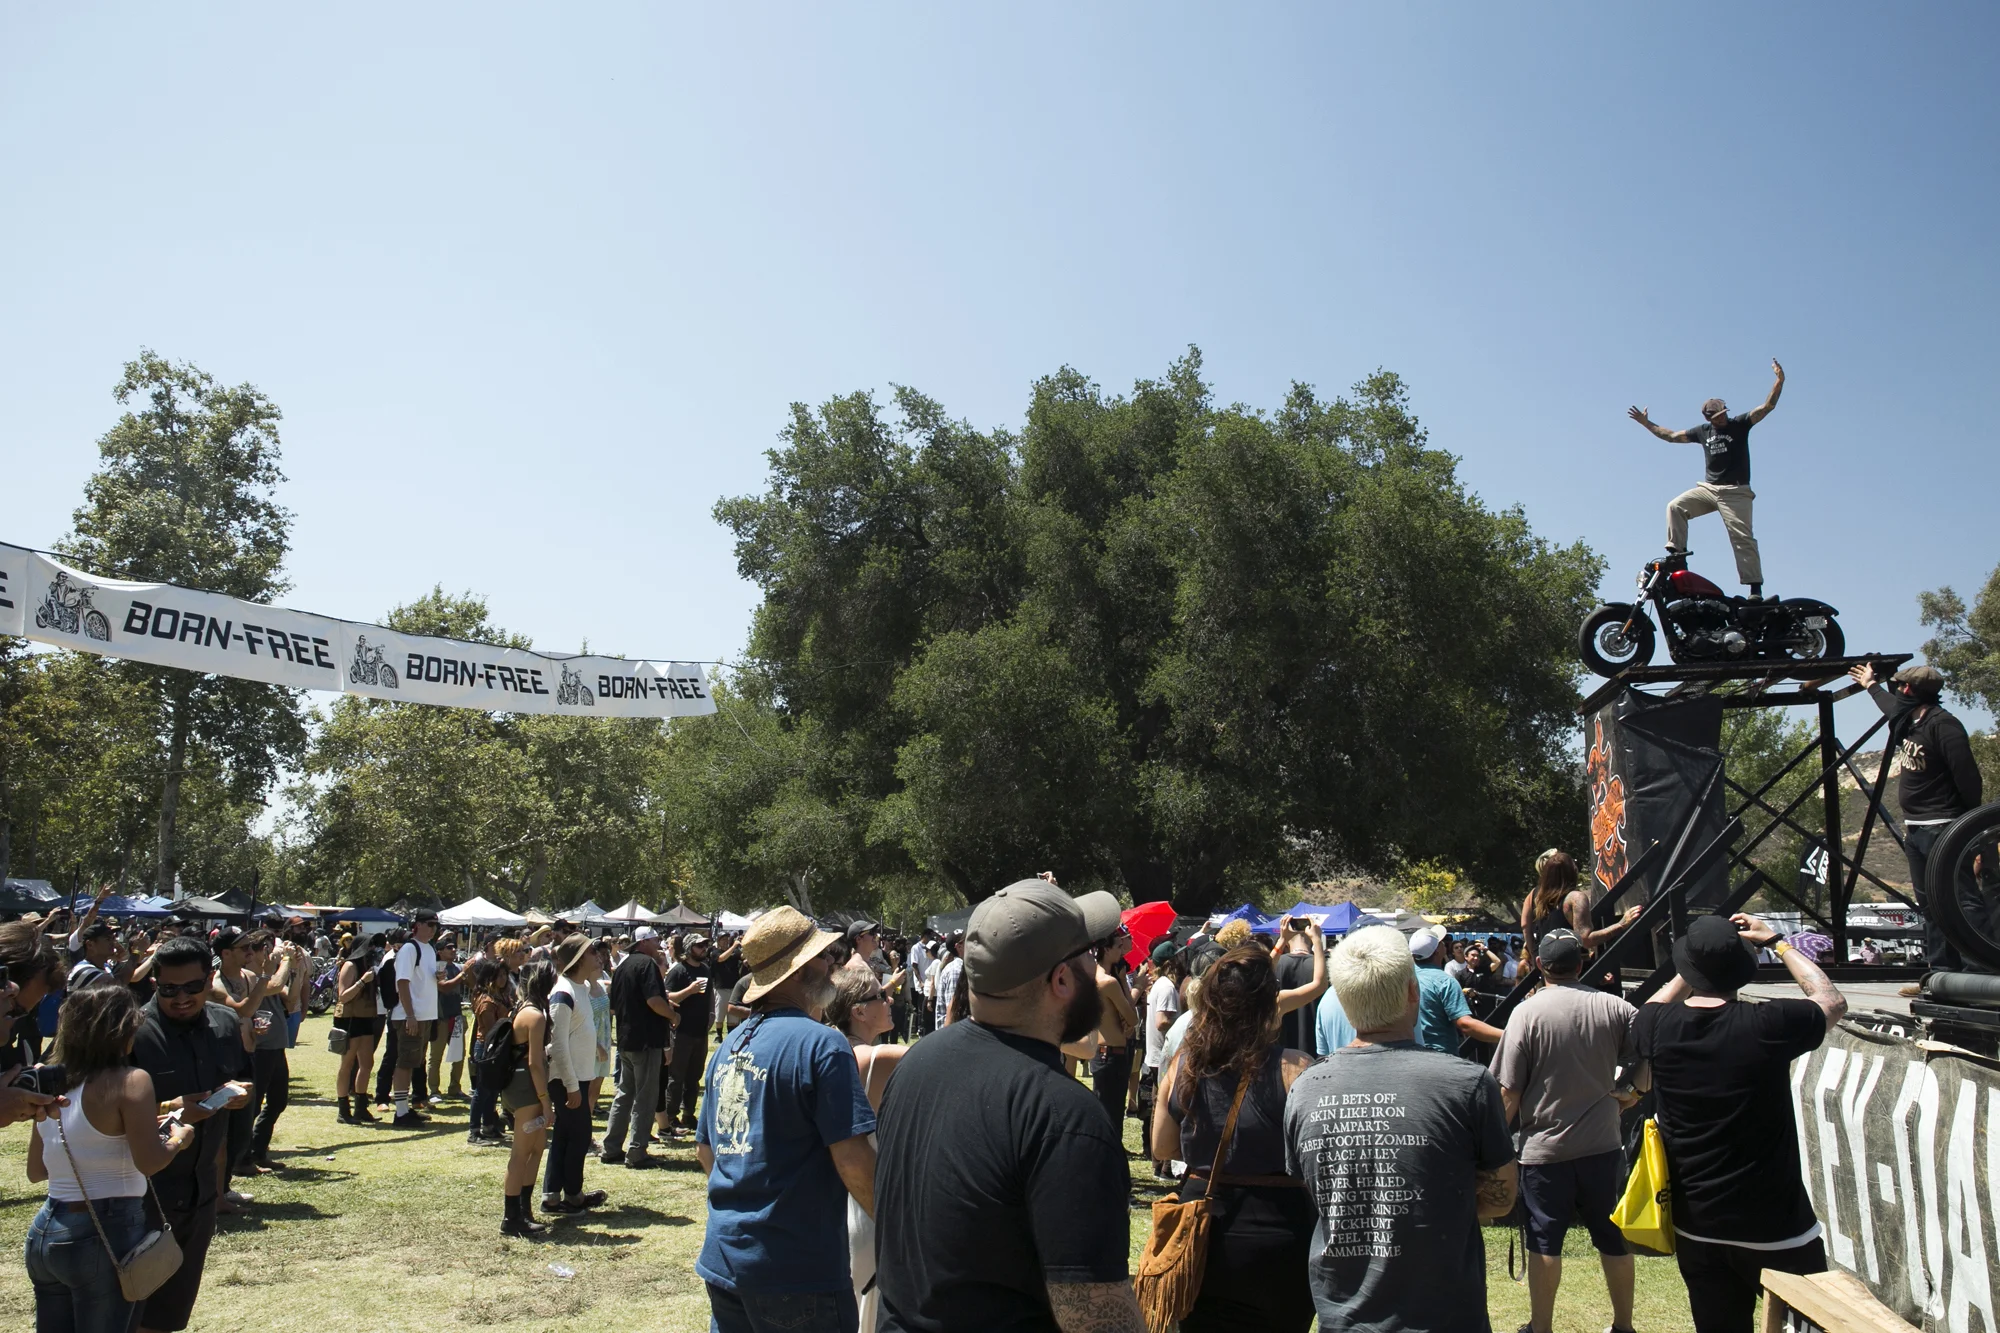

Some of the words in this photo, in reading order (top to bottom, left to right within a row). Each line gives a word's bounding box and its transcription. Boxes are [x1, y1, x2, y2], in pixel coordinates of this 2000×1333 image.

[123, 600, 336, 670] BORN-FREE
[406, 653, 549, 695] BORN-FREE
[598, 674, 706, 700] BORN-FREE
[1317, 1095, 1339, 1108] ALL
[1342, 1093, 1371, 1105] BETS
[1374, 1093, 1397, 1104] OFF
[1310, 1109, 1336, 1123] SKIN
[1339, 1107, 1368, 1119] LIKE
[1371, 1106, 1406, 1118] IRON
[1322, 1121, 1390, 1135] RAMPARTS
[1300, 1138, 1328, 1153] SABER
[1326, 1134, 1371, 1148] TOOTH
[1374, 1134, 1430, 1146] ZOMBIE
[1316, 1149, 1356, 1163] GRACE
[1360, 1148, 1400, 1160] ALLEY
[1319, 1163, 1358, 1176] TRASH
[1361, 1162, 1397, 1174] TALK
[1316, 1177, 1352, 1191] NEVER
[1356, 1176, 1406, 1188] HEALED
[1360, 1189, 1425, 1202] TRAGEDY
[1318, 1204, 1367, 1217] VIOLENT
[1370, 1203, 1409, 1216] MINDS
[1363, 1231, 1394, 1244] TRAP
